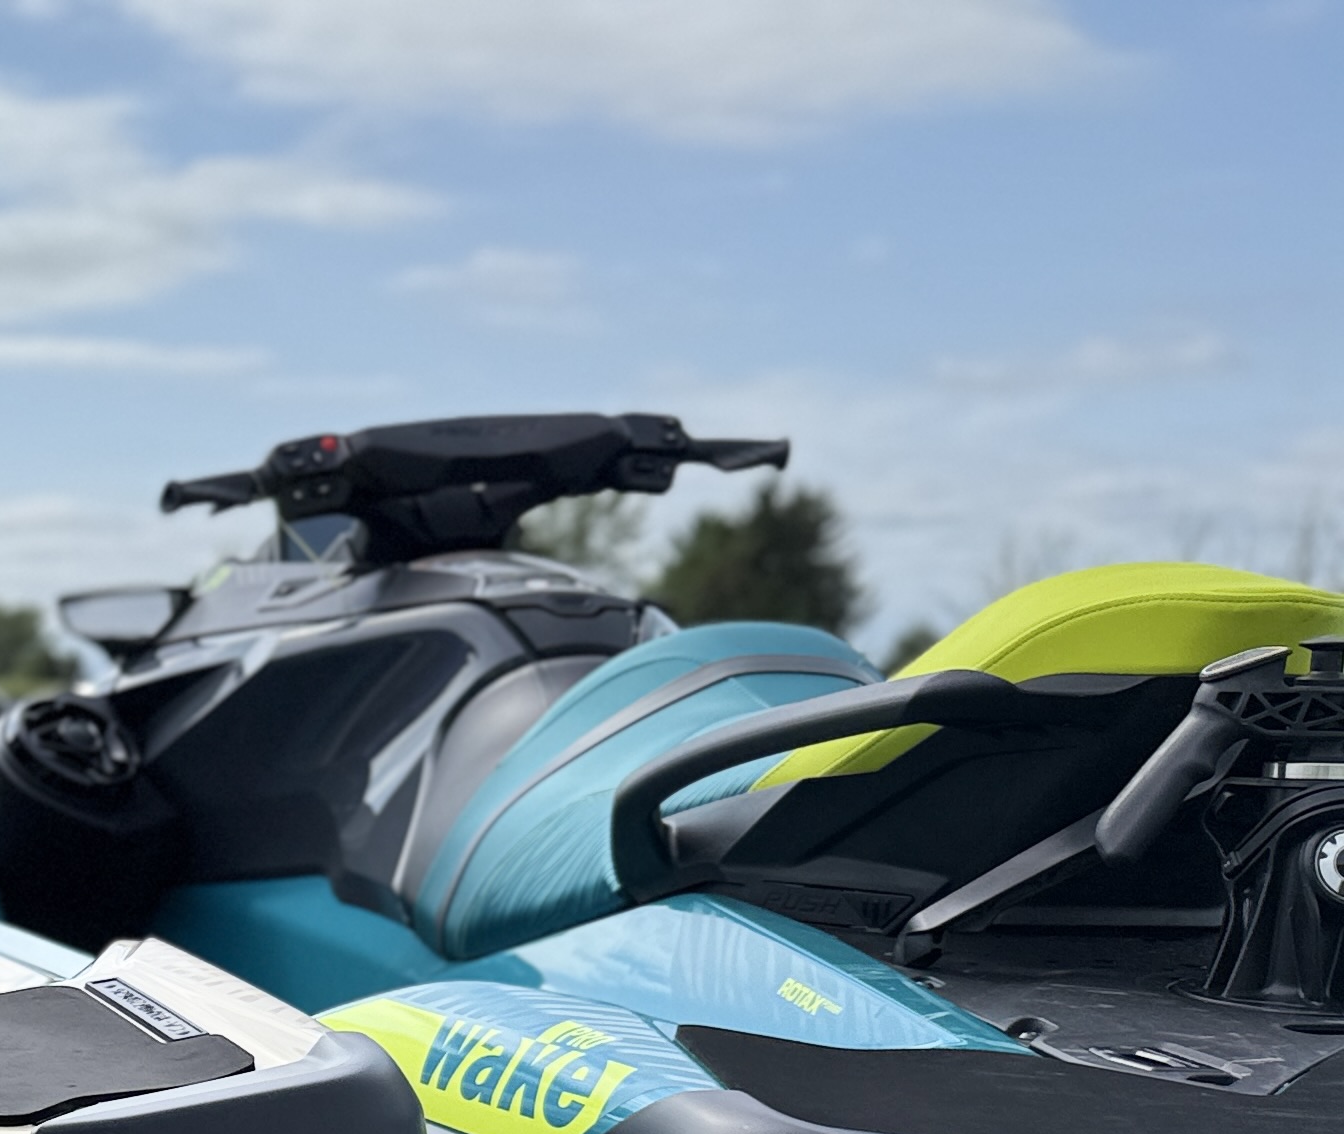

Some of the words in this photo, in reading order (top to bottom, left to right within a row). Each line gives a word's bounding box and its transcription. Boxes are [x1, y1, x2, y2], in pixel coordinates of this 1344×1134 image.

[764, 888, 839, 914] PUSH
[777, 978, 822, 1015] ROTAX
[556, 1024, 617, 1049] PRO
